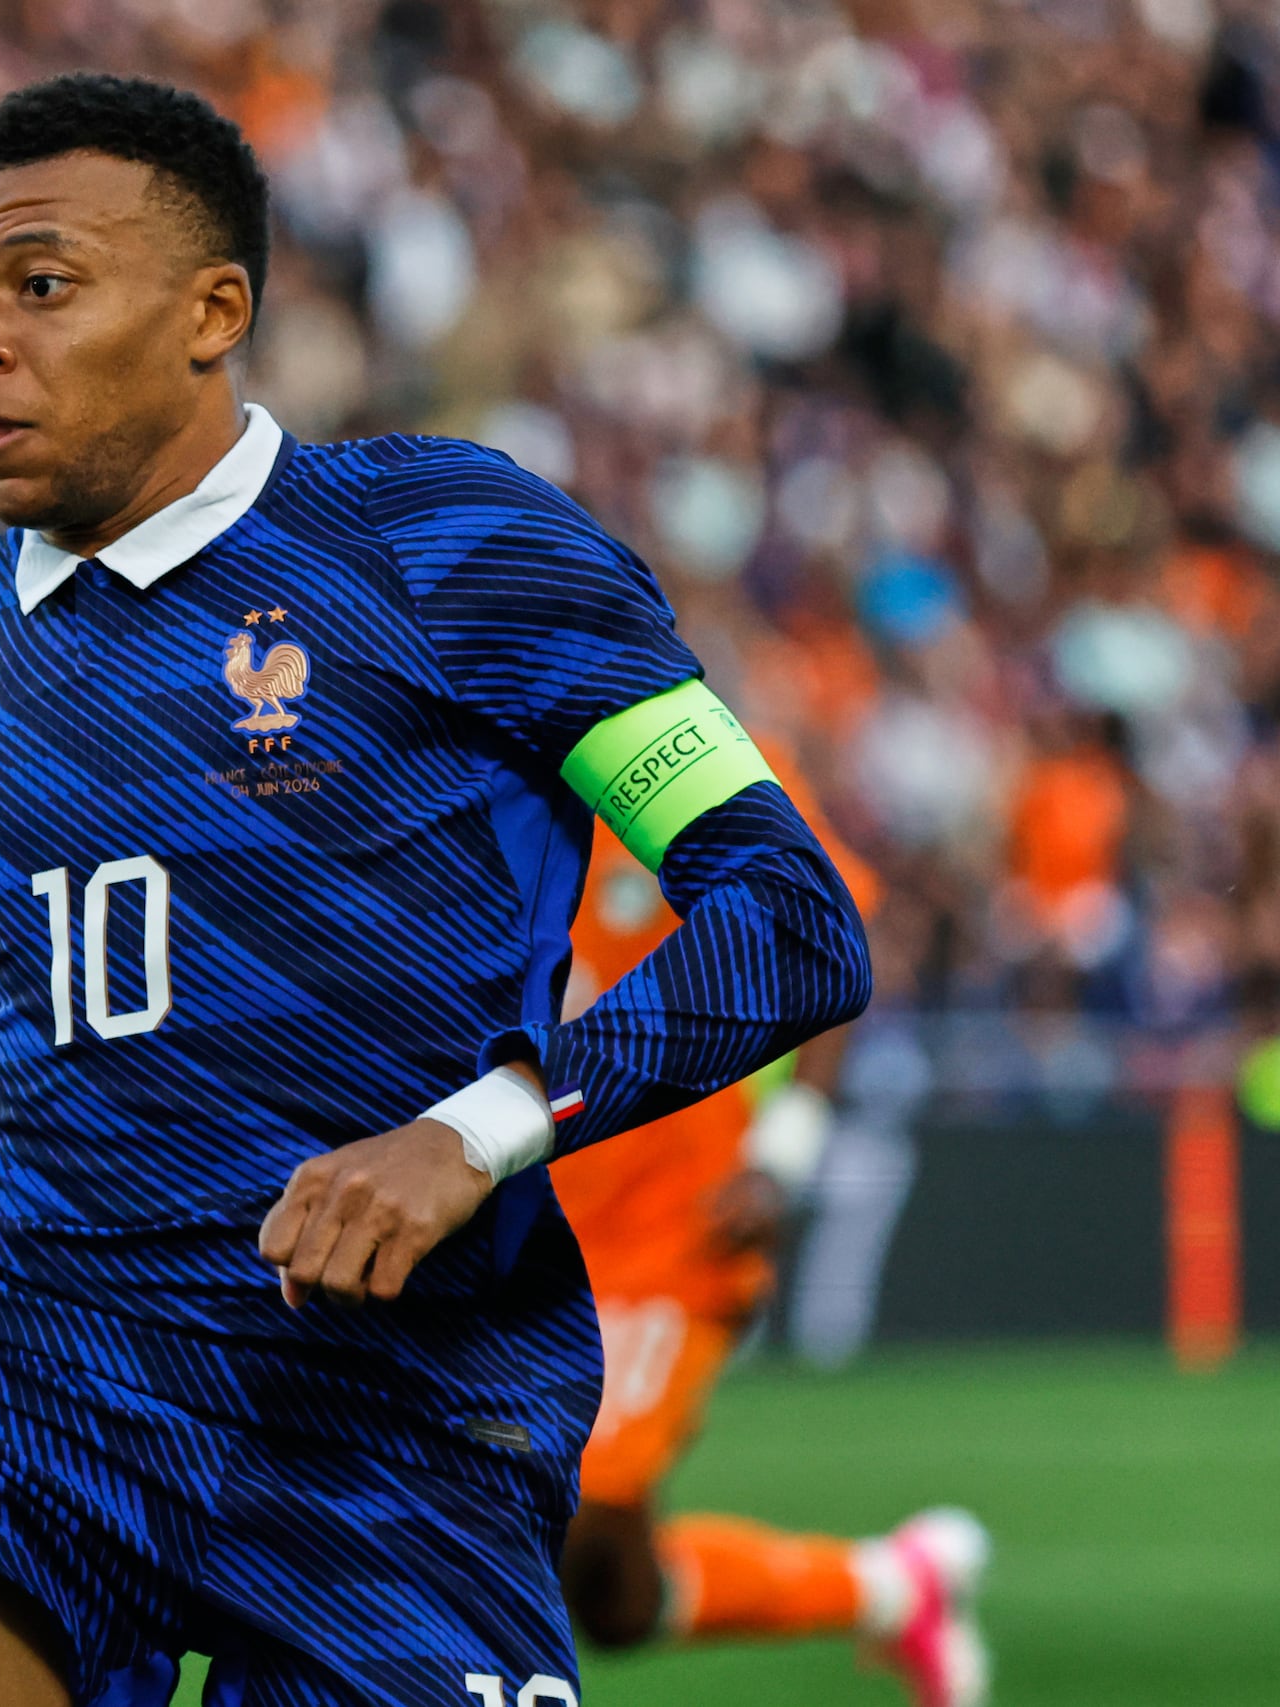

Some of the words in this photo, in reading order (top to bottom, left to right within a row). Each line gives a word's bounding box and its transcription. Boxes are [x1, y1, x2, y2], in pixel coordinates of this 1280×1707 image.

[205, 768, 246, 784] FRANCE
[231, 785, 250, 799] 04
[256, 782, 279, 797] JUIN
[284, 777, 320, 794] 2026
[609, 725, 706, 816] RESPECT
[32, 854, 173, 1047] 10
